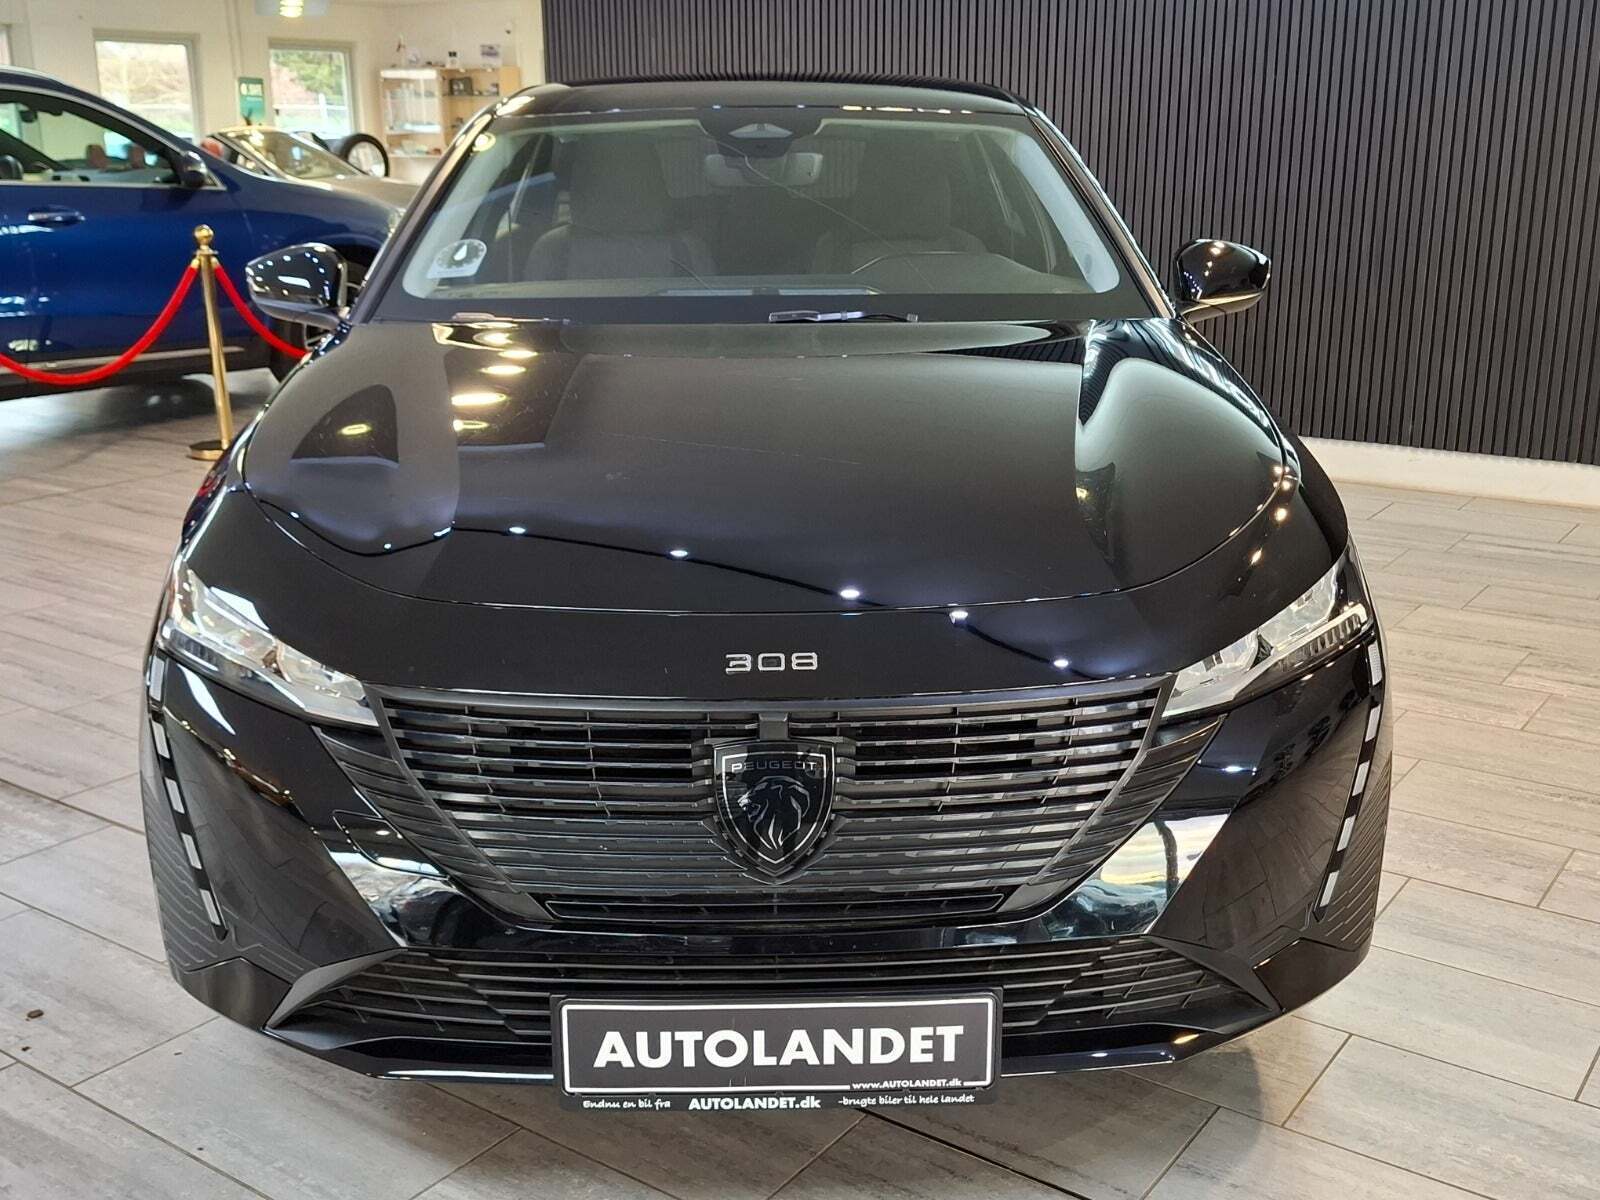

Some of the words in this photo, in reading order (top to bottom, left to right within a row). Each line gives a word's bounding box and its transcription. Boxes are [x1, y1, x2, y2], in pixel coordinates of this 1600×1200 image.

[725, 652, 818, 674] 308
[731, 760, 817, 773] PEUGEOT
[593, 1025, 964, 1068] AUTOLANDET
[852, 1078, 962, 1089] www.AUTOLANDET.dk
[582, 1099, 620, 1109] Endnu
[622, 1101, 637, 1109] en
[638, 1098, 653, 1108] bil
[654, 1098, 671, 1111] fra
[688, 1096, 821, 1110] AUTOLANDET.dk
[879, 1096, 903, 1105] biler
[903, 1095, 917, 1104] til
[919, 1094, 939, 1104] hele
[940, 1093, 975, 1103] landet
